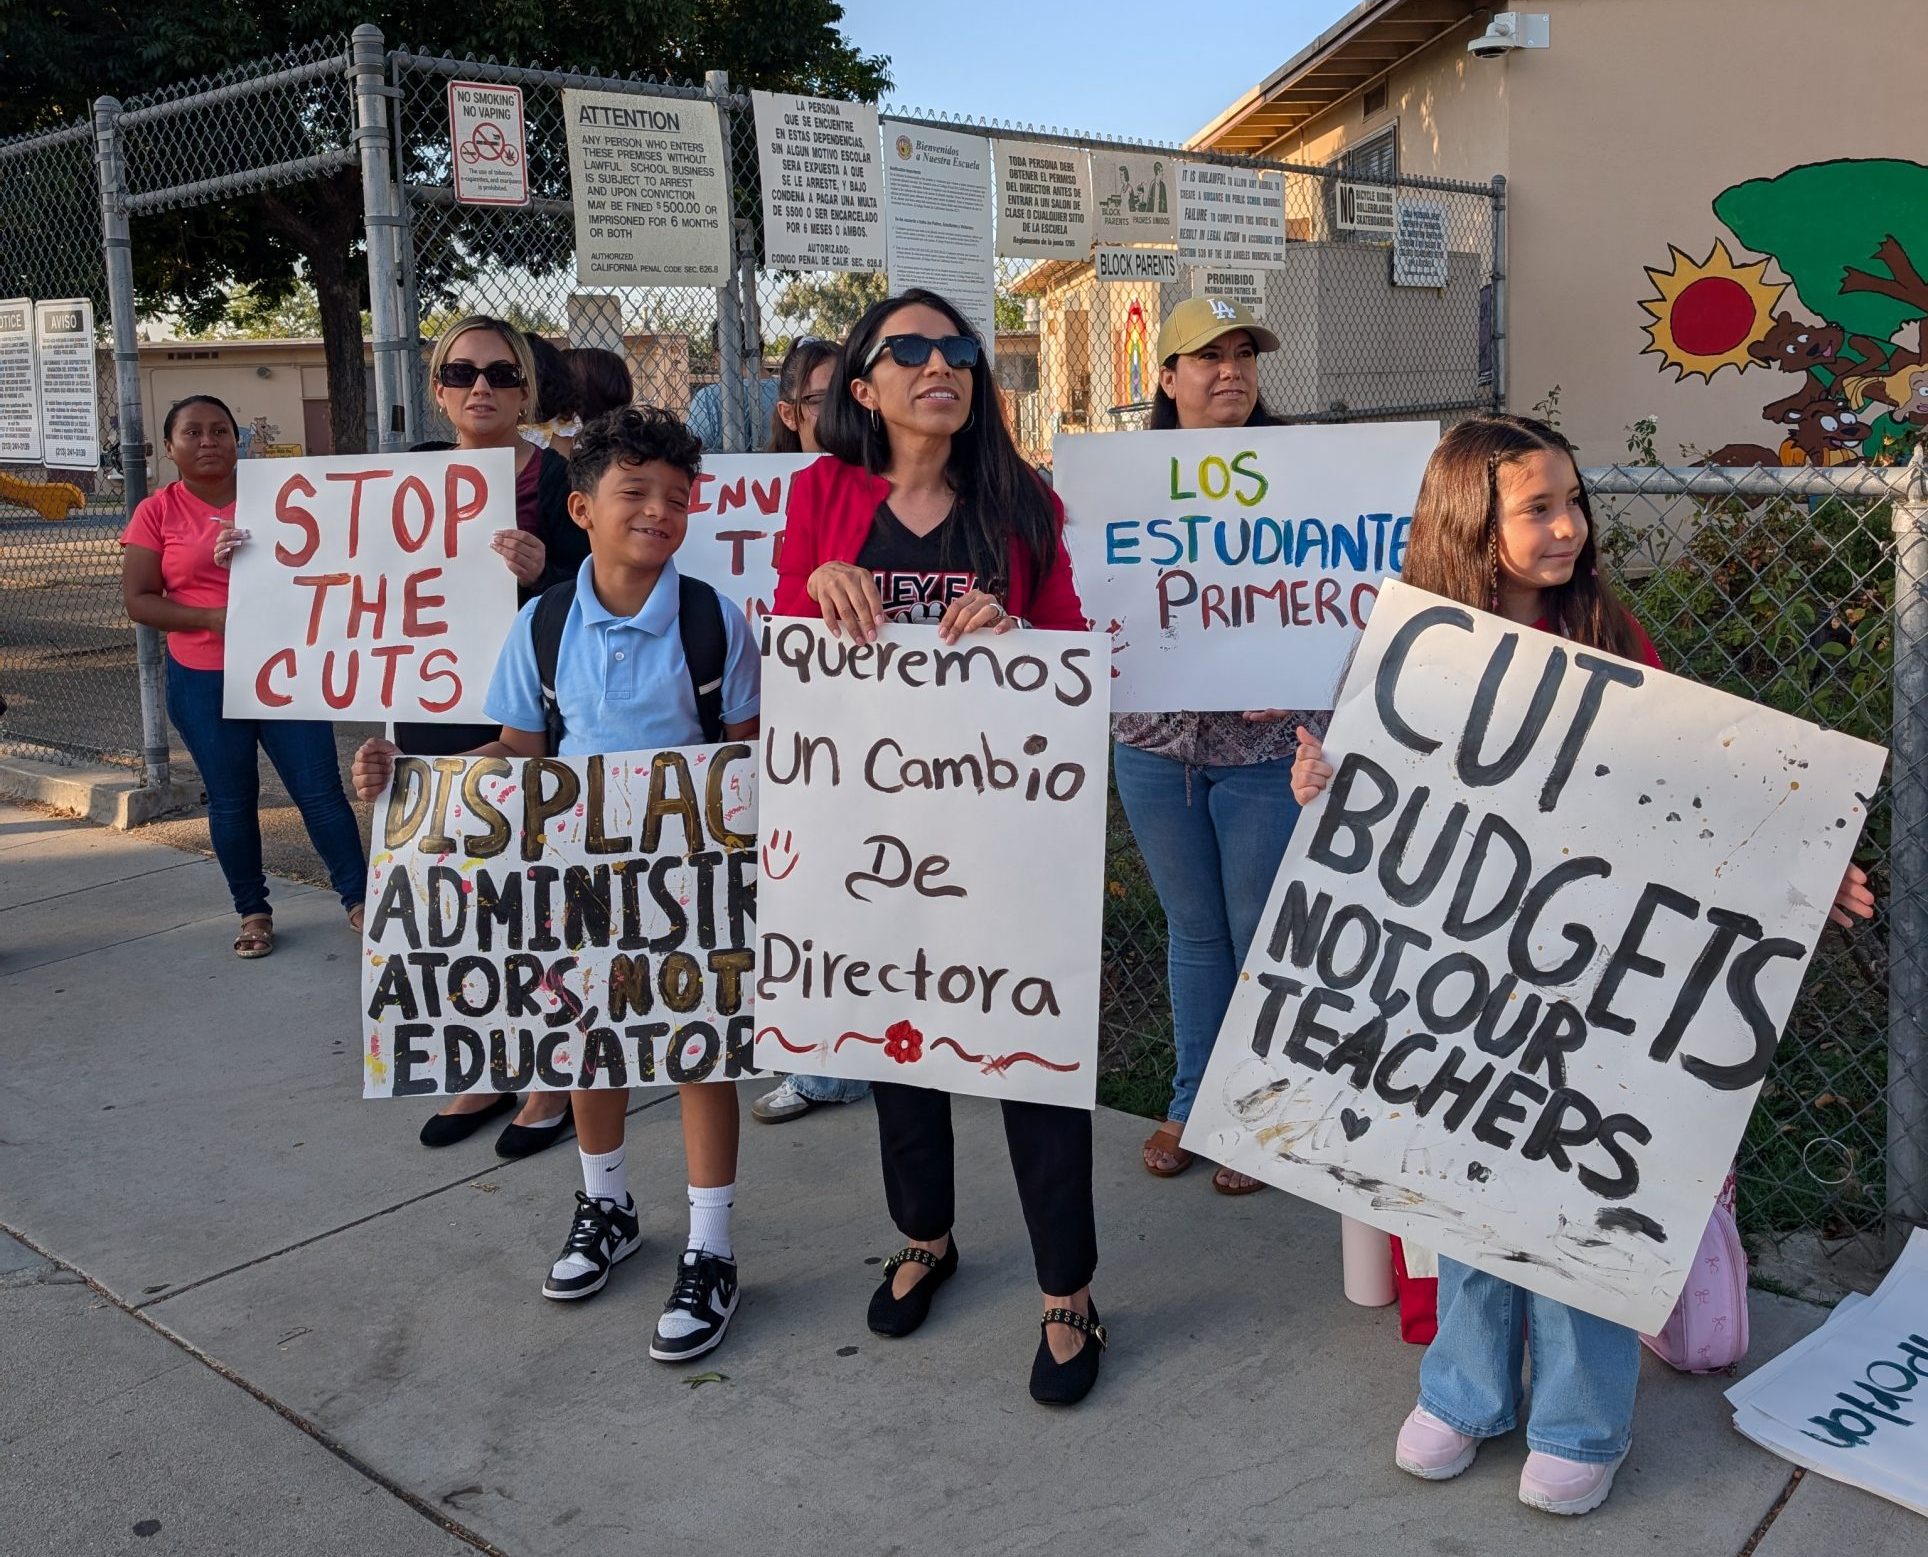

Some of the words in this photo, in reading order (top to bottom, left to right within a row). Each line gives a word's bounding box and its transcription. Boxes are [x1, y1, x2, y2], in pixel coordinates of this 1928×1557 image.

[457, 91, 470, 102] NO
[473, 92, 515, 106] SMOKING
[463, 106, 476, 118] NO
[479, 107, 511, 120] VAPING
[796, 100, 806, 112] LA
[808, 102, 840, 116] PERSONA
[579, 105, 680, 130] ATTENTION
[784, 114, 800, 126] QUE
[802, 116, 812, 127] SE
[814, 116, 854, 132] ENCUENTRE
[582, 135, 600, 146] ANY
[605, 136, 642, 148] PERSON
[645, 140, 668, 150] WHO
[670, 141, 704, 152] ENTERS
[776, 128, 786, 140] EN
[788, 130, 810, 142] ESTAS
[583, 148, 614, 158] THESE
[618, 150, 662, 162] PREMISES
[668, 152, 706, 164] WITHOUT
[771, 142, 783, 154] SIN
[786, 144, 810, 158] ALGUN
[812, 146, 838, 160] MOTIVO
[841, 150, 872, 164] ESCOLAR
[916, 140, 960, 156] Bienvenidos
[584, 160, 622, 172] LAWFUL
[630, 163, 668, 174] SCHOOL
[672, 166, 715, 177] BUSINESS
[782, 158, 801, 172] SERA
[804, 161, 840, 176] EXPUESTA
[843, 166, 848, 176] A
[850, 166, 864, 178] QUE
[922, 152, 951, 166] Nuestra
[952, 157, 980, 170] Escuela
[1008, 156, 1027, 167] TODA
[1028, 158, 1058, 170] PERSONA
[1060, 161, 1075, 172] DEBE
[586, 173, 594, 183] IS
[598, 174, 640, 186] SUBJECT
[646, 177, 656, 186] TO
[660, 178, 693, 188] ARREST
[782, 174, 791, 186] SE
[794, 176, 802, 187] LE
[842, 180, 846, 190] Y
[850, 180, 866, 192] BAJO
[1009, 168, 1038, 181] OBTENER
[1040, 172, 1048, 182] EL
[1048, 172, 1076, 185] PERMISO
[588, 186, 607, 196] AND
[610, 187, 637, 198] UPON
[640, 189, 696, 200] CONVICTION
[772, 189, 805, 203] CONDENA
[808, 192, 814, 204] A
[816, 192, 838, 206] PAGAR
[840, 194, 855, 207] UNA
[858, 196, 878, 208] MULTA
[1006, 182, 1018, 192] DEL
[1020, 182, 1051, 196] DIRECTOR
[1053, 186, 1072, 197] ANTES
[1074, 188, 1082, 198] DE
[588, 200, 606, 210] MAY
[611, 202, 623, 210] BE
[626, 202, 652, 212] FINED
[704, 206, 717, 214] OR
[1008, 194, 1033, 206] ENTRAR
[1034, 198, 1039, 207] A
[1040, 198, 1050, 208] UN
[1051, 198, 1072, 210] SALON
[1073, 200, 1081, 210] DE
[1340, 186, 1355, 224] NO
[772, 204, 782, 216] DE
[786, 206, 803, 218] $500
[806, 208, 811, 218] O
[815, 208, 828, 220] SER
[830, 209, 878, 223] ENCARCELADO
[1005, 208, 1024, 219] CLASE
[1026, 209, 1032, 220] O
[1033, 210, 1068, 222] CUALQUIER
[1068, 212, 1085, 224] SITIO
[1102, 207, 1121, 216] BLOCK
[1184, 208, 1208, 222] FAILURE
[588, 214, 645, 226] IMPRISONED
[649, 217, 666, 226] FOR
[670, 216, 678, 227] 6
[682, 218, 718, 228] MONTHS
[786, 222, 800, 234] POR
[804, 222, 808, 234] 6
[811, 223, 832, 236] MESES
[836, 224, 840, 236] O
[1022, 222, 1030, 232] DE
[1032, 222, 1040, 232] LA
[1042, 224, 1068, 234] ESCUELA
[1104, 217, 1130, 226] PARENTS
[590, 228, 603, 238] OR
[608, 228, 632, 238] BOTH
[590, 252, 634, 260] AUTHORIZED
[772, 254, 796, 264] CODIGO
[798, 255, 818, 266] PENAL
[821, 256, 830, 266] DE
[867, 258, 882, 268] 626.8
[590, 263, 638, 272] CALIFORNIA
[700, 266, 718, 274] 626.8
[1100, 253, 1132, 276] BLOCK
[1136, 254, 1176, 277] PARENTS
[1207, 273, 1254, 286] PROHIBIDO
[1206, 298, 1237, 320] LA
[51, 314, 78, 330] AVISO
[1169, 449, 1269, 508] LOS
[275, 463, 489, 568] STOP
[292, 567, 448, 647] THE
[255, 645, 463, 714] CUTS
[1374, 606, 1645, 813] CUT
[765, 726, 841, 788] Un
[864, 731, 1086, 802] Cambio
[844, 833, 969, 904] De
[1308, 753, 1807, 1091] BUDGETS
[755, 932, 1062, 1018] Directora
[608, 947, 757, 1023] NOT
[1267, 879, 1432, 1019] NOT
[1415, 951, 1588, 1092] OUR
[1256, 973, 1654, 1200] TEACHERS
